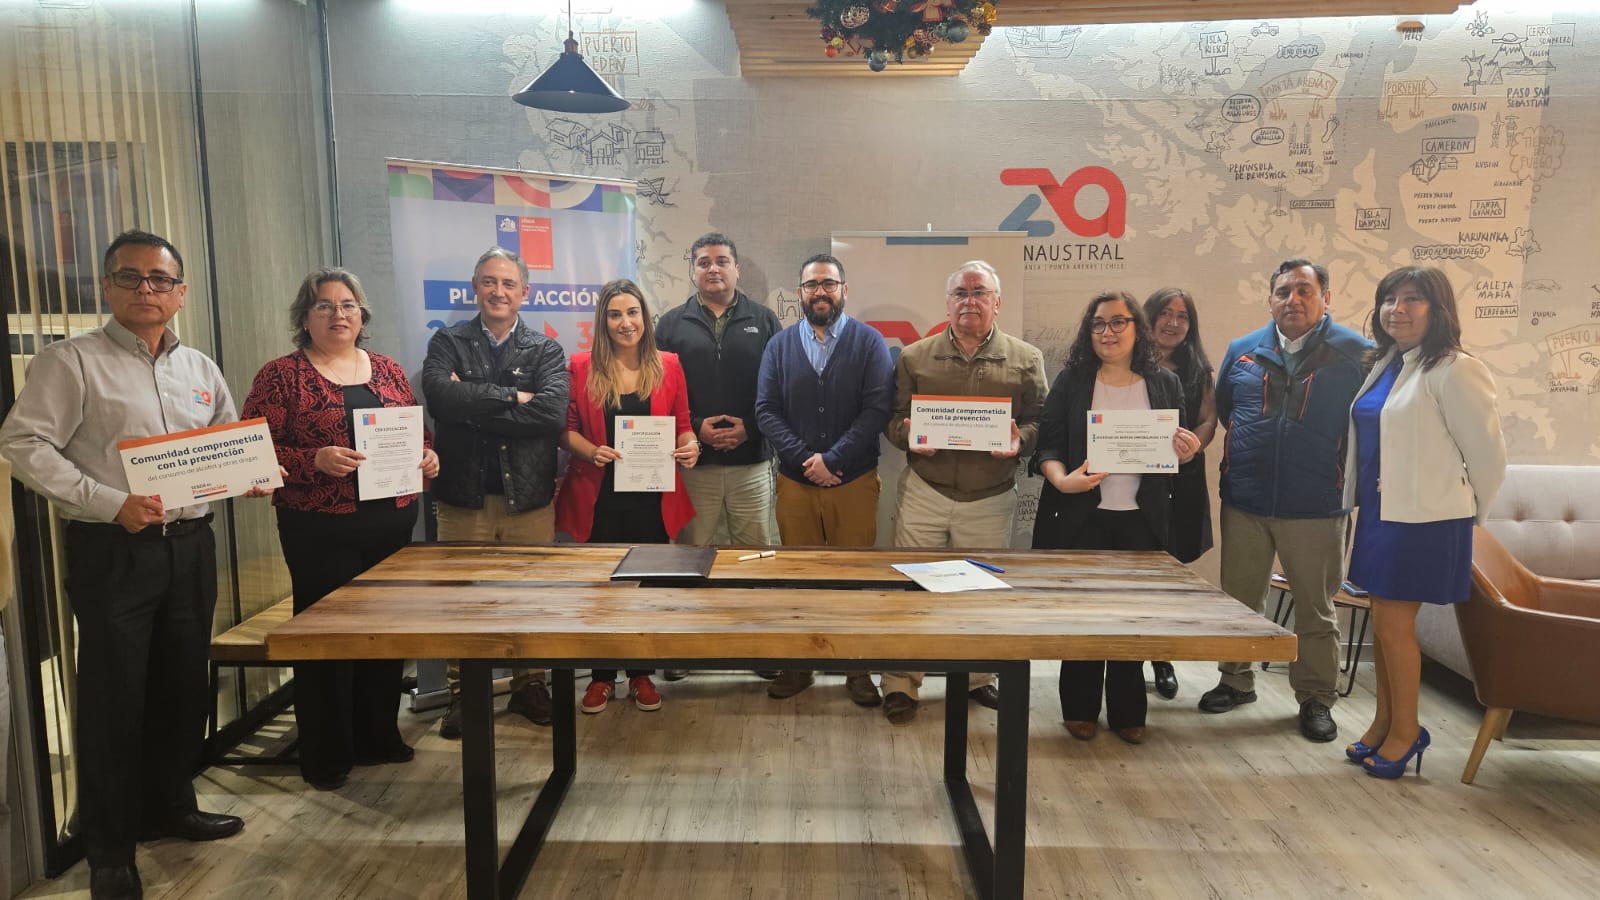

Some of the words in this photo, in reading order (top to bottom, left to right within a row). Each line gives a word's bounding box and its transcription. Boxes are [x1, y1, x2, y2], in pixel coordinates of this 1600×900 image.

[1528, 26, 1552, 37] CERRO
[584, 34, 632, 55] PUERTO
[1206, 35, 1222, 44] ISLA
[1204, 44, 1226, 54] RIESCO
[1387, 82, 1427, 96] PORVENIR
[1506, 87, 1530, 98] PASO
[1534, 86, 1550, 97] SAN
[1507, 98, 1550, 108] SEBASTIAN
[1425, 141, 1471, 153] CAMERON
[1364, 210, 1381, 218] ISLA
[1358, 218, 1387, 228] DAWSON
[1458, 231, 1509, 243] KARUKINKA
[1023, 243, 1125, 262] NAUSTRAL
[1552, 329, 1591, 350] PUERTO
[916, 406, 955, 414] Comunidad
[955, 408, 1007, 416] comprometida
[953, 414, 991, 422] prevención
[130, 447, 190, 466] Comunidad
[192, 433, 264, 455] comprometida
[157, 461, 177, 471] con
[177, 458, 188, 468] la
[189, 446, 245, 469] prevención
[147, 474, 158, 482] del
